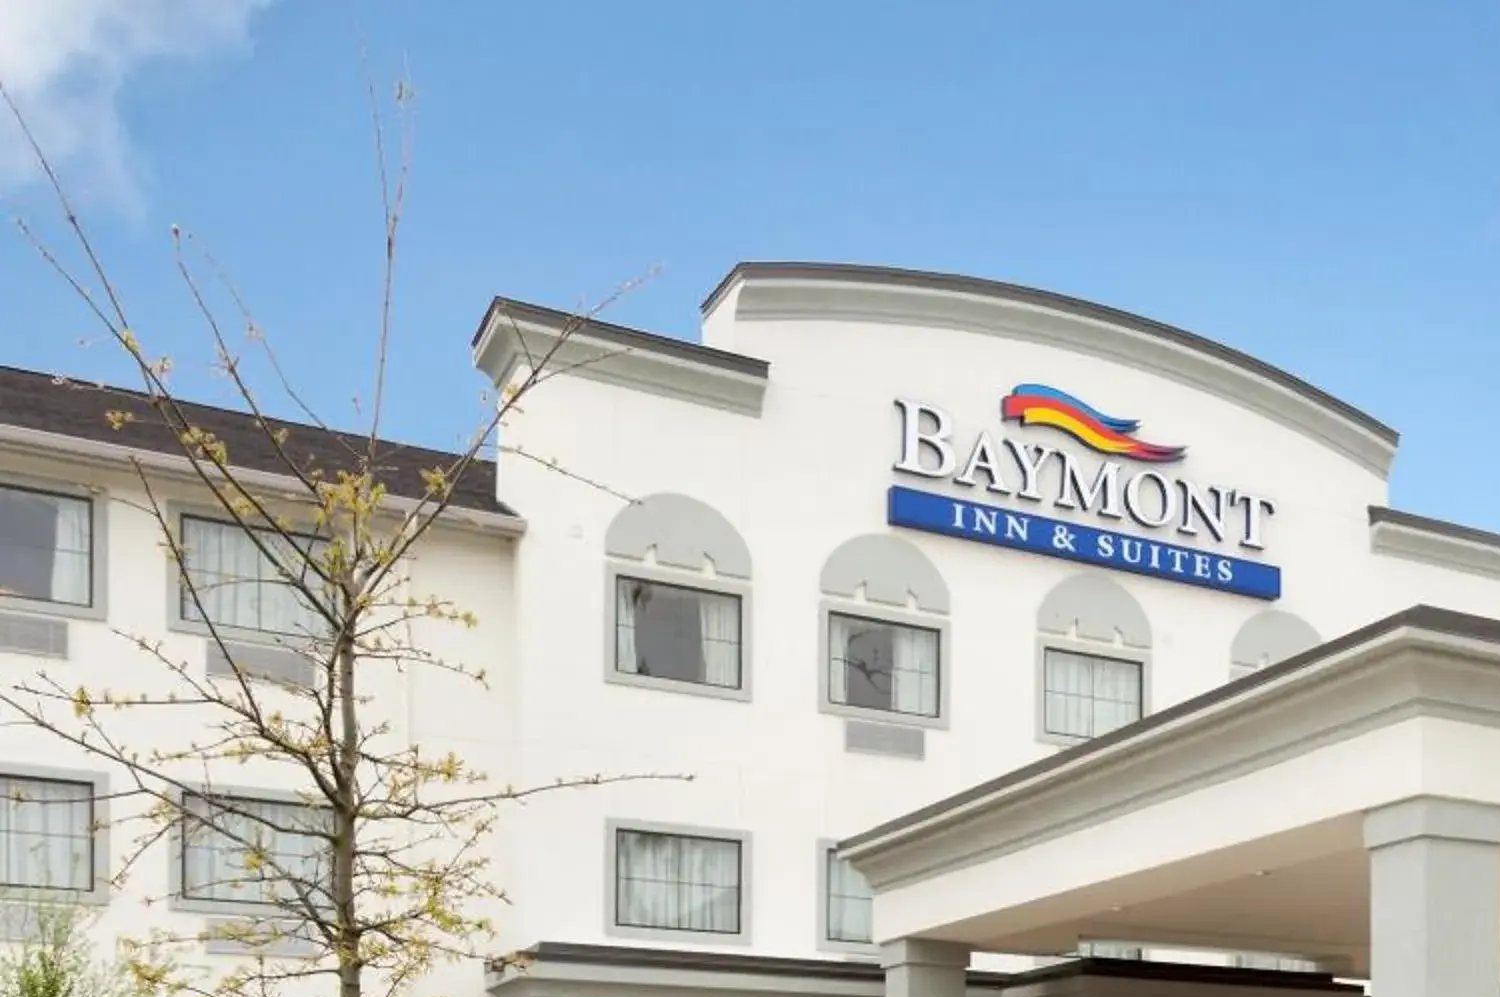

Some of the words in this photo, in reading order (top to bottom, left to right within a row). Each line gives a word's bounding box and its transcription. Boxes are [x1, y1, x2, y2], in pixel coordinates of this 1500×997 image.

[893, 399, 1276, 550] BAYMONT
[951, 503, 1030, 543] INN
[1052, 525, 1076, 552] &
[1097, 535, 1233, 582] SUITES
